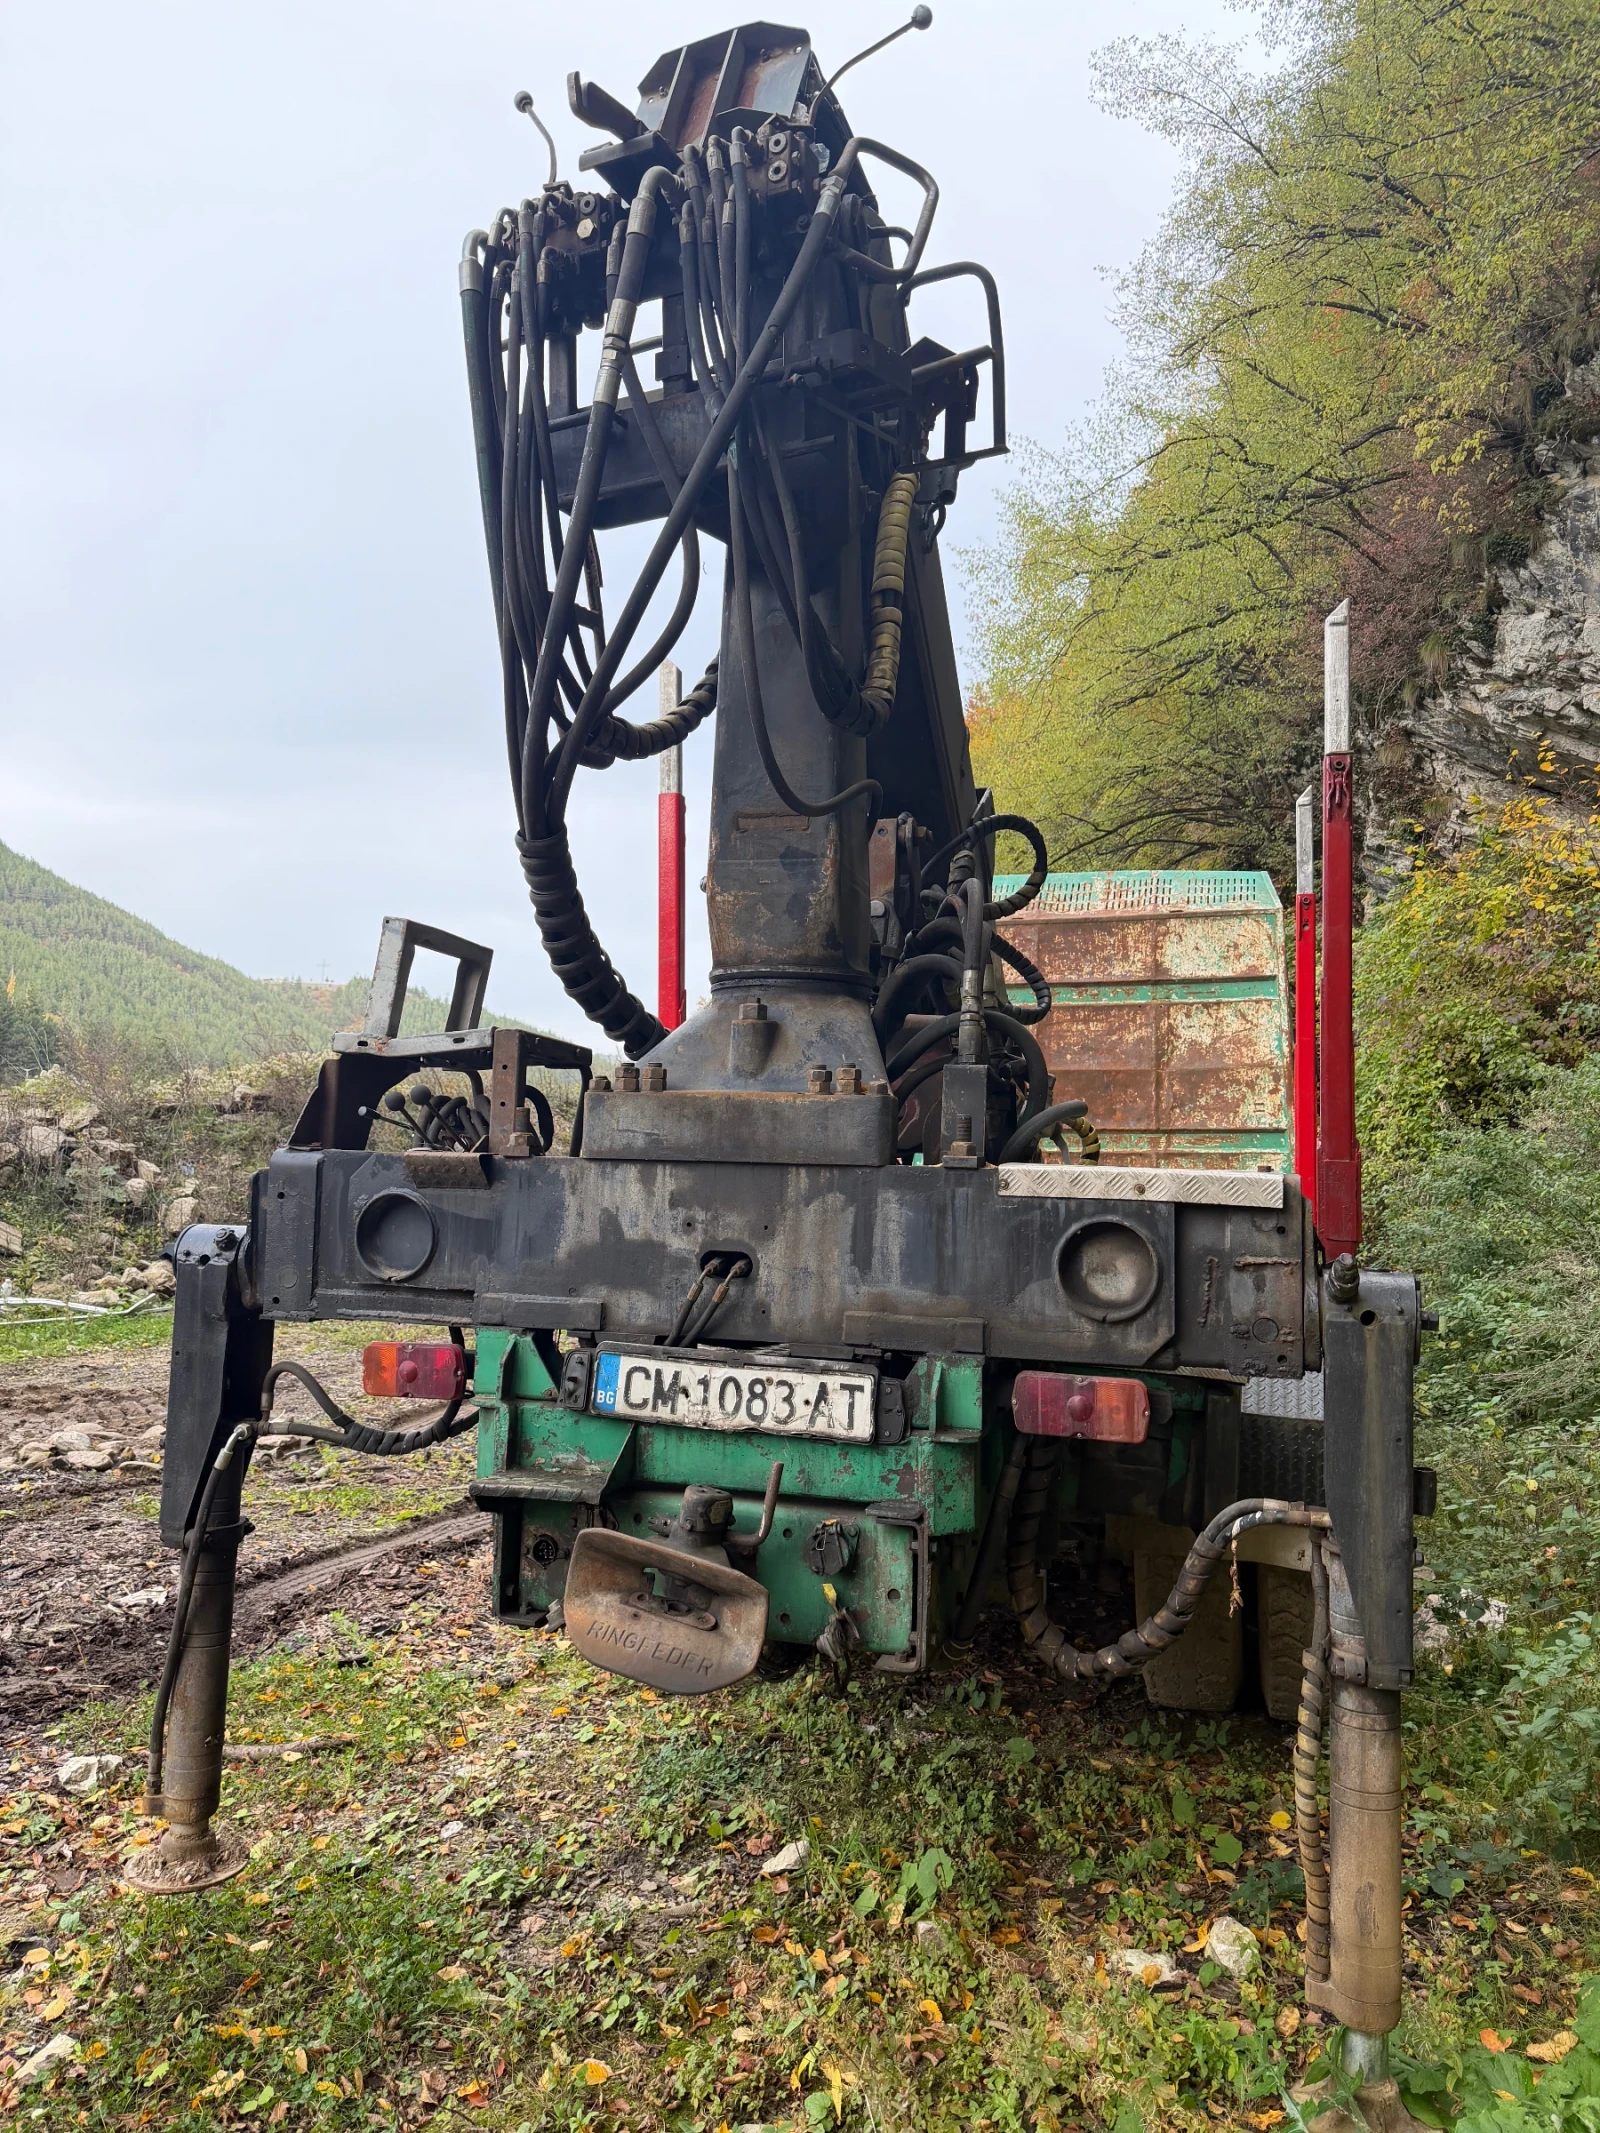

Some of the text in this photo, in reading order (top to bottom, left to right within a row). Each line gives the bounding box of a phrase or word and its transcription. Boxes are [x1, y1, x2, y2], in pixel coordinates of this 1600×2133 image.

[596, 1389, 615, 1405] BG
[622, 1365, 865, 1431] CM 1083 AT
[586, 1620, 714, 1677] RINGFEDER
